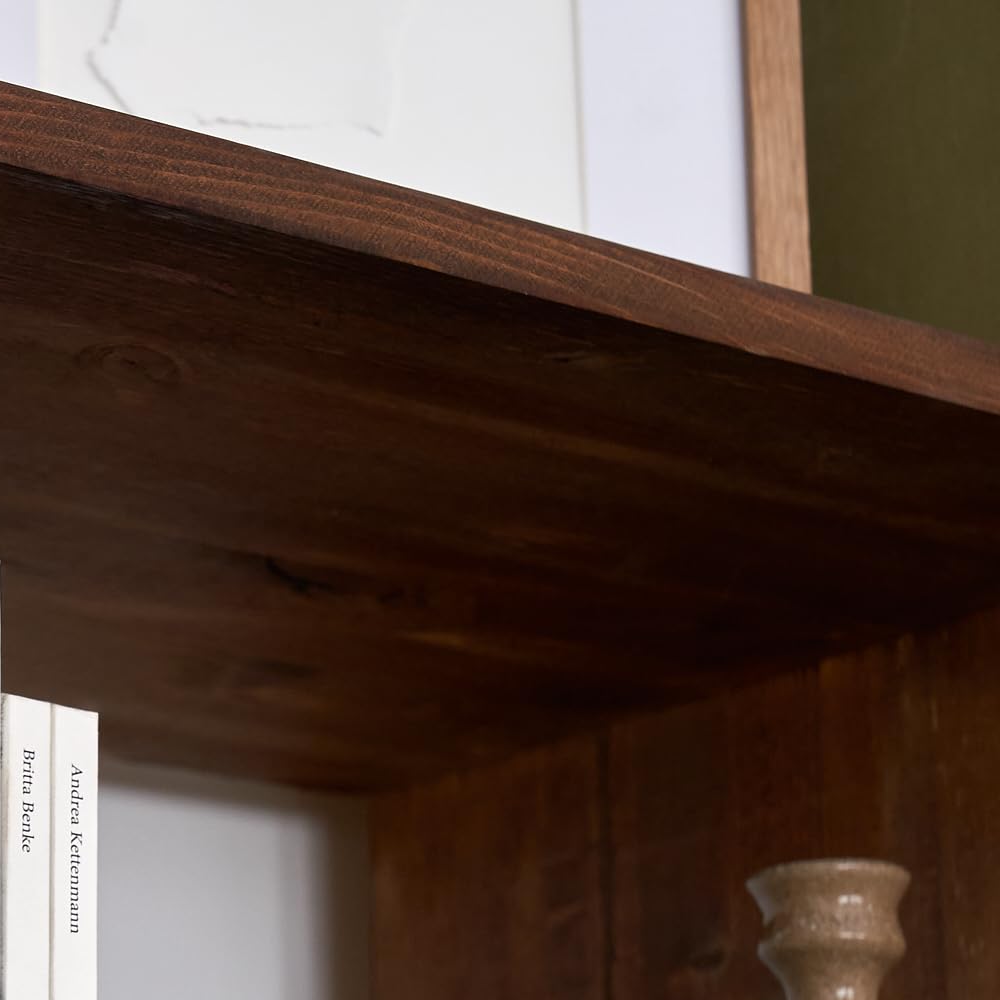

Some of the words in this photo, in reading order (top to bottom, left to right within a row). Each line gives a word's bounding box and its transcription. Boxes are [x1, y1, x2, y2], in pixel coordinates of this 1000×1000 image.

[22, 749, 36, 795] Britta
[70, 763, 84, 825] Andrea
[21, 801, 35, 853] Benke
[70, 831, 83, 934] Kettenmann
